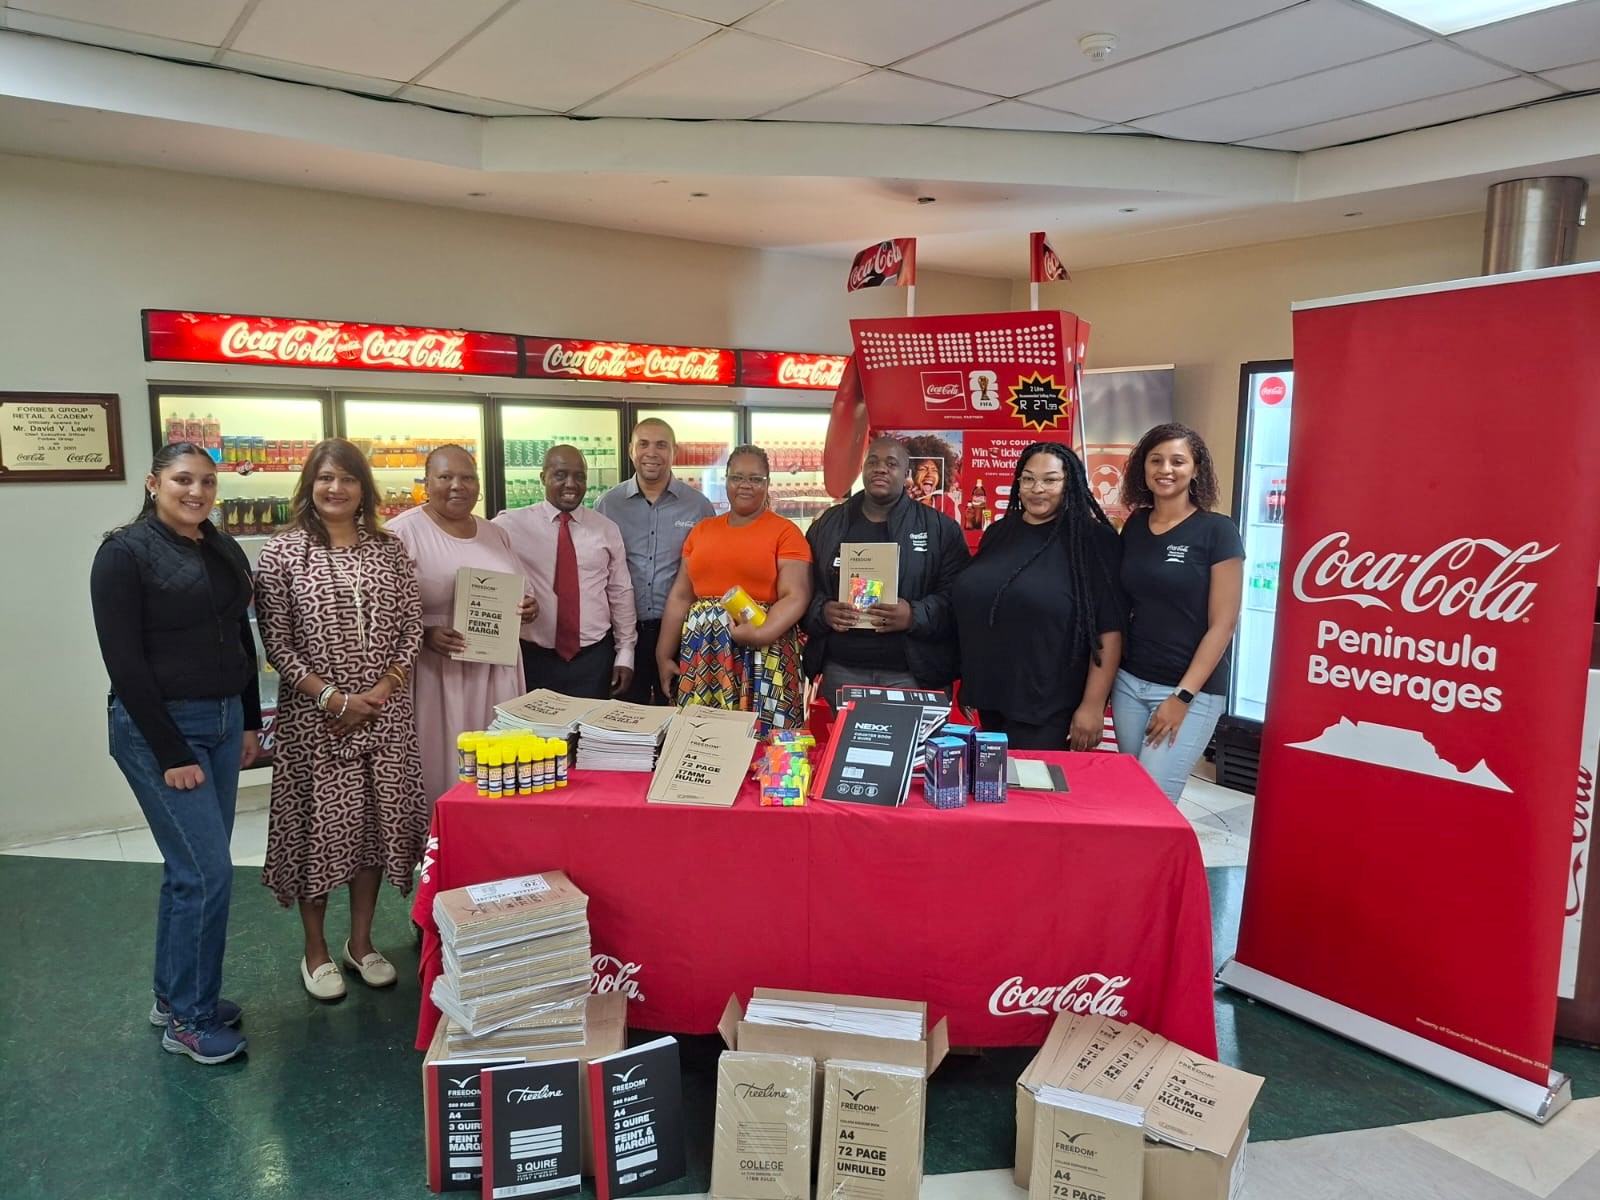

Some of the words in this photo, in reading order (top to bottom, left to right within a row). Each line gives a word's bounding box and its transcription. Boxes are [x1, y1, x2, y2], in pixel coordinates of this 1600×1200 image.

[221, 322, 339, 362] Coca-Cola
[361, 331, 464, 369] Coca-Cola
[543, 344, 630, 377] Coca-Cola
[644, 350, 719, 381] Coca-Cola
[927, 384, 960, 396] Coca-Cola
[1020, 400, 1027, 410] R
[16, 453, 45, 461] Coca-Cola
[67, 453, 103, 463] Coca-Cola
[971, 448, 988, 456] Win
[1000, 448, 1022, 457] ticke
[971, 459, 990, 468] FIFA
[1293, 532, 1560, 622] Coca-Cola
[482, 612, 502, 620] PAGE
[469, 620, 492, 628] FEINT
[468, 626, 499, 636] MARGIN
[1317, 620, 1497, 672] Peninsula
[1308, 655, 1502, 713] Beverages
[855, 722, 889, 731] NEXX
[690, 740, 720, 749] FREEDOM
[678, 769, 705, 778] 17MM
[696, 764, 721, 773] PAGE
[675, 774, 712, 784] RULING
[988, 973, 1130, 1017] Coca-Cola
[1179, 1060, 1215, 1078] FREEDOM
[612, 1079, 646, 1093] FREEDOM
[1171, 1075, 1186, 1084] A4
[507, 1084, 564, 1104] Treeline
[734, 1083, 789, 1099] Treeline
[1167, 1082, 1181, 1092] 72
[1184, 1091, 1216, 1106] PAGE
[1162, 1091, 1195, 1108] 17MM
[614, 1108, 626, 1118] A4
[841, 1102, 876, 1112] FREEDOM
[1158, 1095, 1202, 1118] RULING
[623, 1114, 650, 1128] QUIRE
[449, 1135, 479, 1143] FEINT
[614, 1130, 643, 1144] FEINT
[840, 1130, 855, 1140] A4
[616, 1135, 655, 1154] MARGIN
[1056, 1142, 1094, 1156] FREEDOM
[838, 1146, 853, 1156] 72
[856, 1148, 886, 1161] PAGE
[516, 1164, 522, 1172] 3
[525, 1158, 557, 1171] QUIRE
[740, 1160, 784, 1170] COLLEGE
[837, 1162, 886, 1176] UNRULED
[1054, 1170, 1071, 1181] A4
[1053, 1185, 1068, 1196] 72
